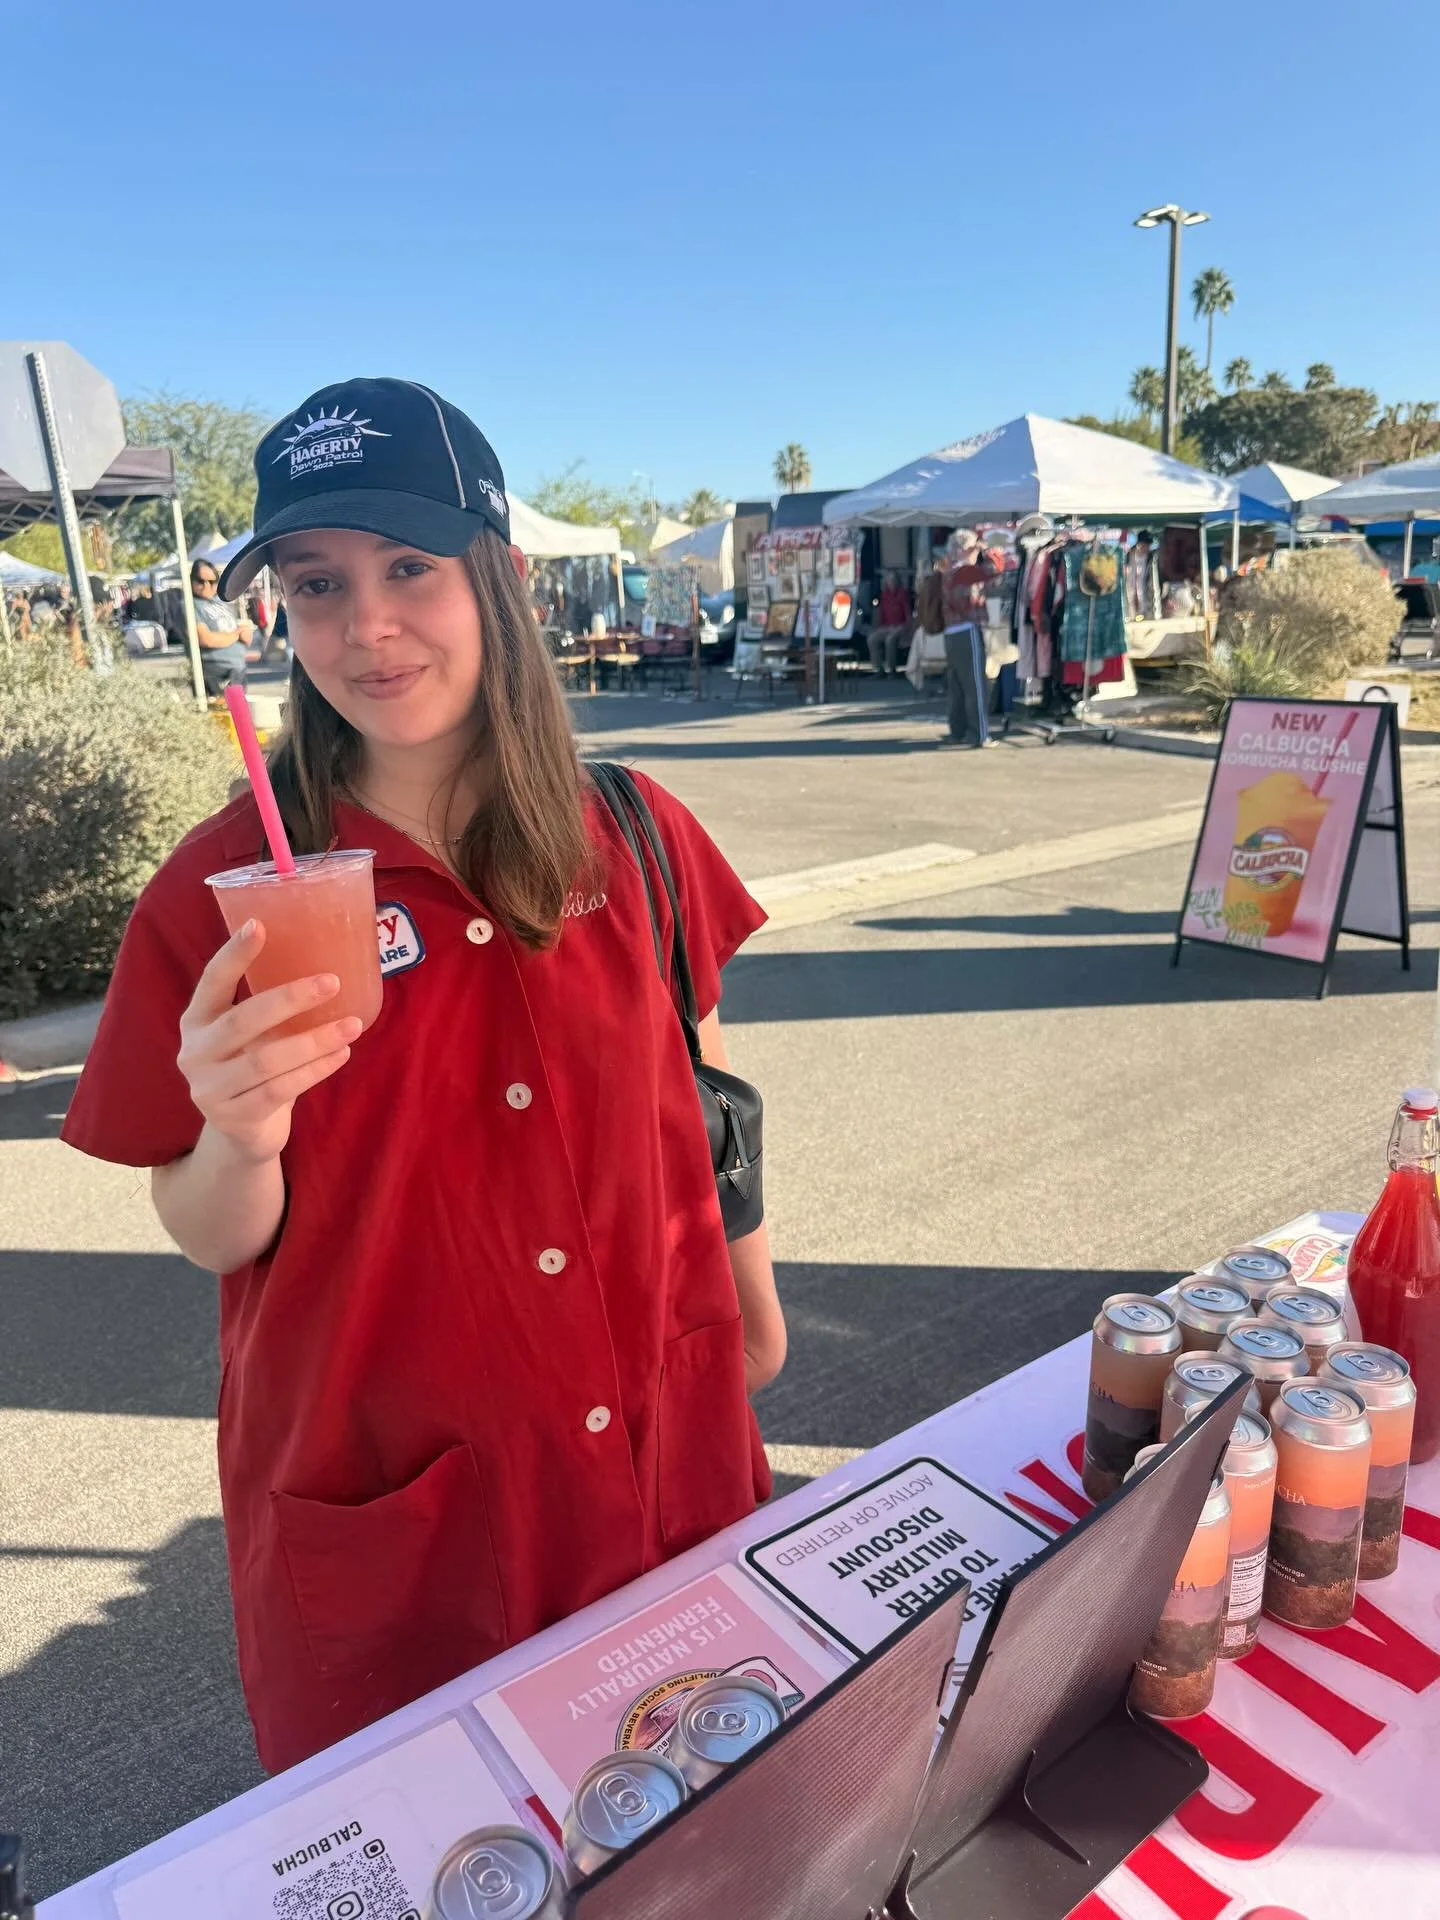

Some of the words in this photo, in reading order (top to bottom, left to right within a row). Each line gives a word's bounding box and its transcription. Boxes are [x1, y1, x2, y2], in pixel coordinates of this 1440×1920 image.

[290, 437, 362, 465] HAGERTY
[290, 457, 322, 475] Dawn
[323, 449, 363, 465] Patrol
[313, 461, 334, 472] 2022
[1271, 712, 1327, 732] NEW
[1238, 732, 1351, 757] CALBUCHA
[1302, 754, 1367, 776] SLUSHIE
[877, 1474, 932, 1511] ACTIVE
[1277, 1484, 1307, 1506] CHA
[849, 1505, 877, 1526] OR
[776, 1521, 854, 1567] RETIRED
[827, 1506, 943, 1579] DISCOUNT
[860, 1528, 967, 1598] MILITARY
[959, 1549, 999, 1574] TO
[884, 1567, 961, 1619] OFFER
[1172, 1581, 1197, 1592] HA
[596, 1595, 722, 1673] FERMENTED
[688, 1624, 712, 1648] IS
[713, 1611, 738, 1637] IT
[1141, 1659, 1168, 1672] verage
[566, 1640, 688, 1720] NATURALLY
[666, 1671, 717, 1689] UPLIFTING
[636, 1685, 666, 1712] SOCIAL
[272, 1821, 363, 1877] CALBUCHA
